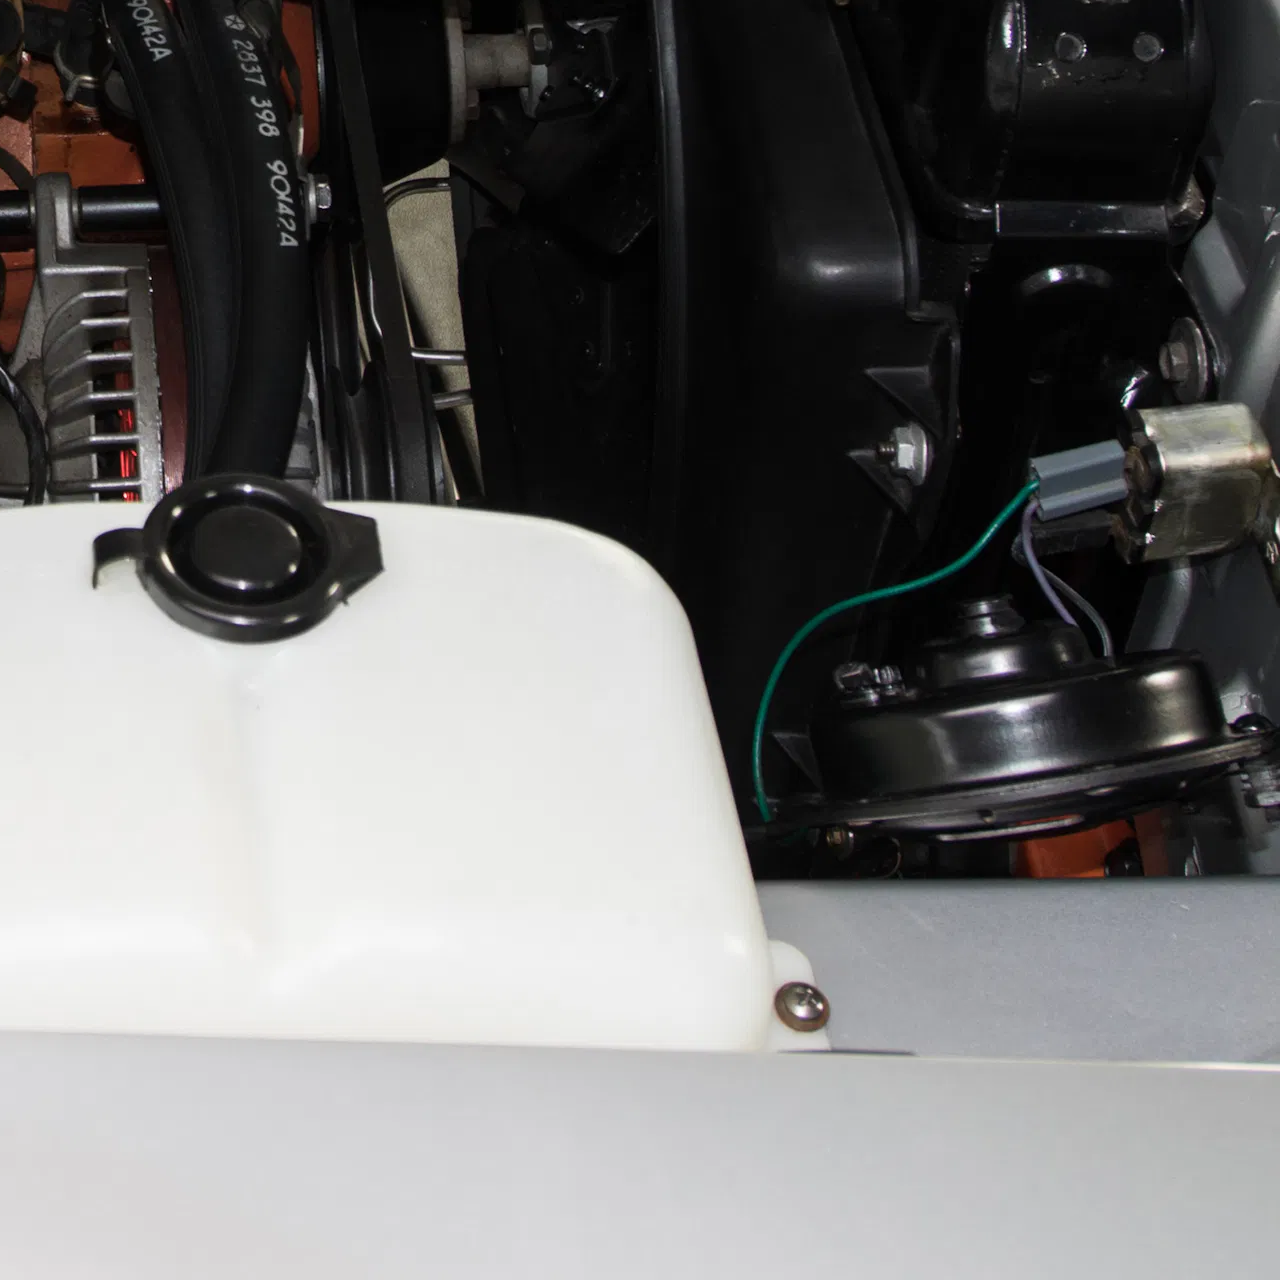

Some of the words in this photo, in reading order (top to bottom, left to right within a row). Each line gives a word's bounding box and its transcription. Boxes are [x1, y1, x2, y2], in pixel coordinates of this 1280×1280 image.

[232, 38, 267, 88] 2837
[250, 95, 281, 138] 398
[266, 159, 300, 247] 90142A
